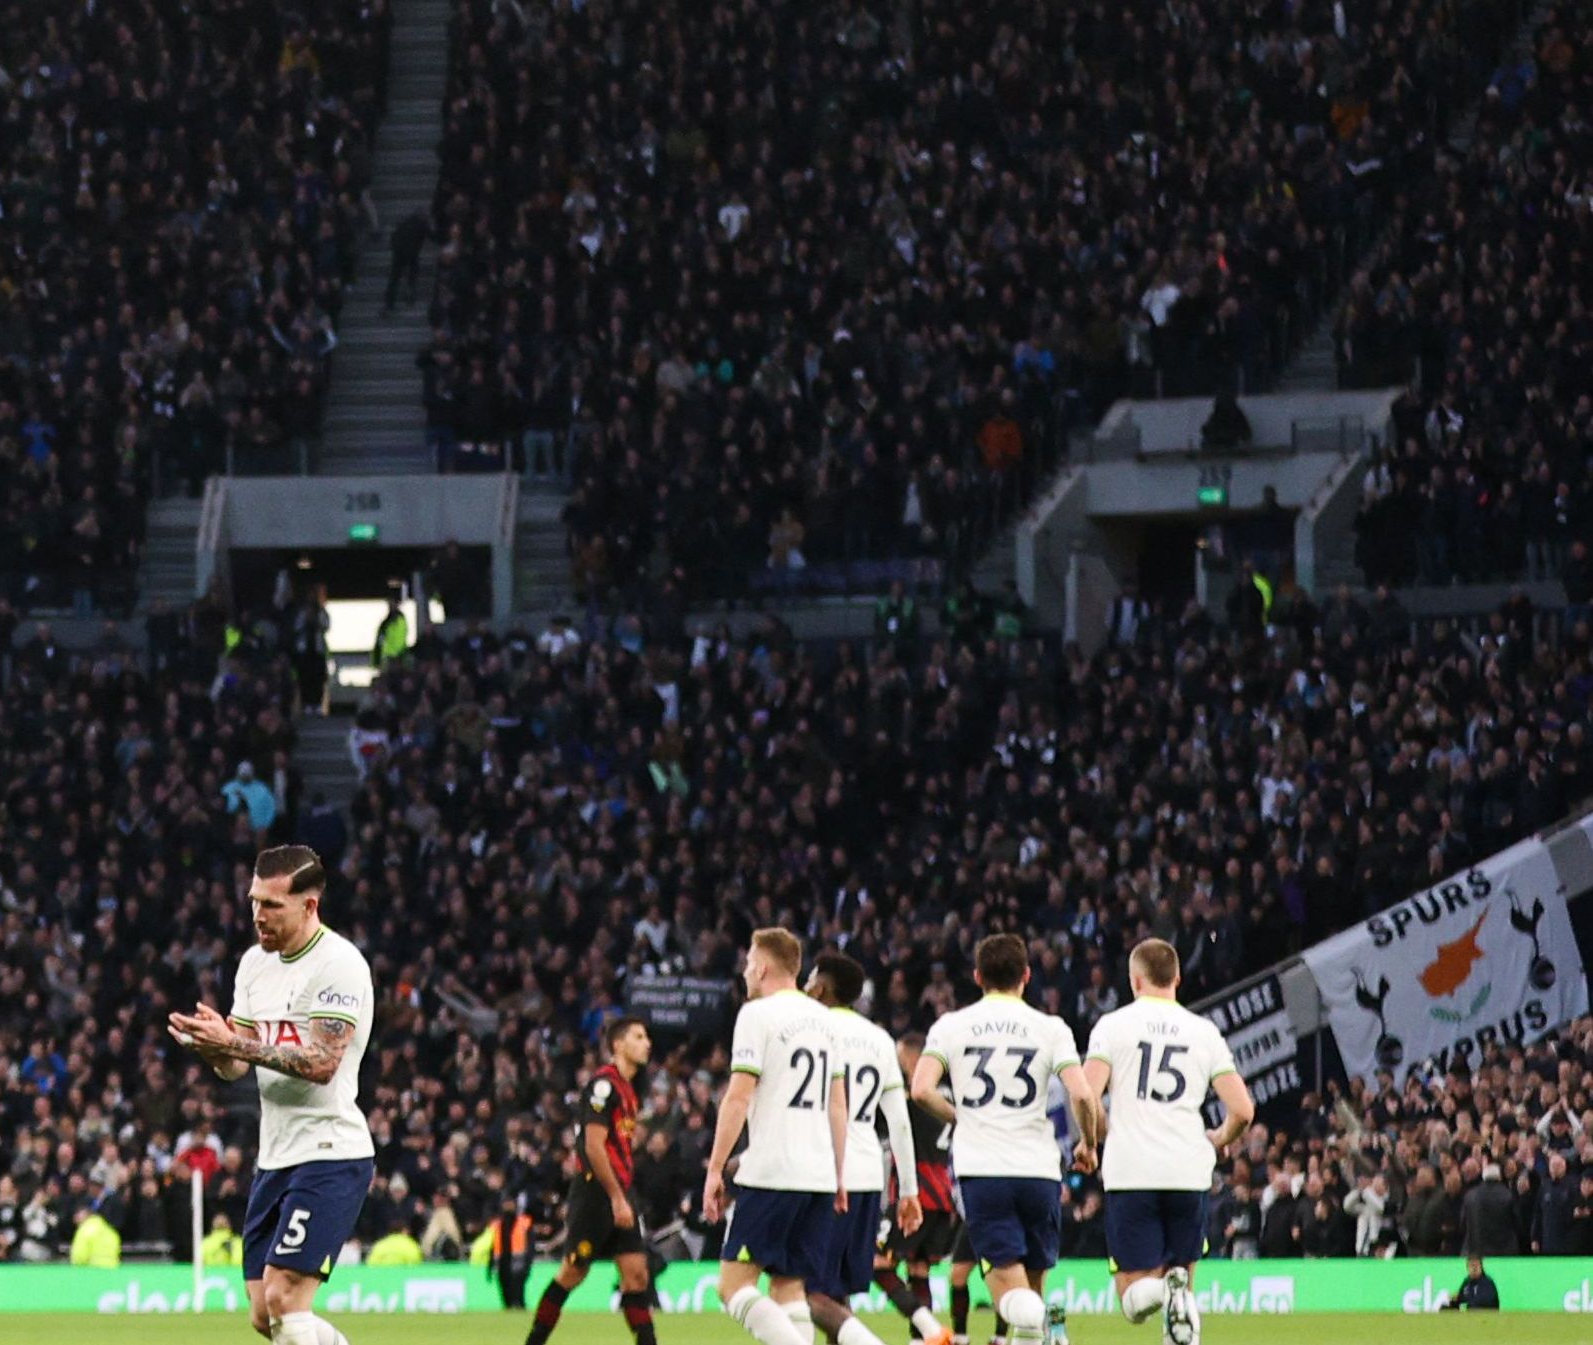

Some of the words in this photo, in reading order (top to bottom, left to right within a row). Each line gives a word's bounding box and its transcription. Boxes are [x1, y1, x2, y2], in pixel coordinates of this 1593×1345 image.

[1367, 867, 1492, 947] SPURS
[318, 986, 359, 1007] cinch
[788, 1047, 829, 1111] 21
[845, 1063, 880, 1122] 12
[962, 1046, 1039, 1109] 33
[1136, 1040, 1189, 1103] 15
[282, 1209, 311, 1247] 5
